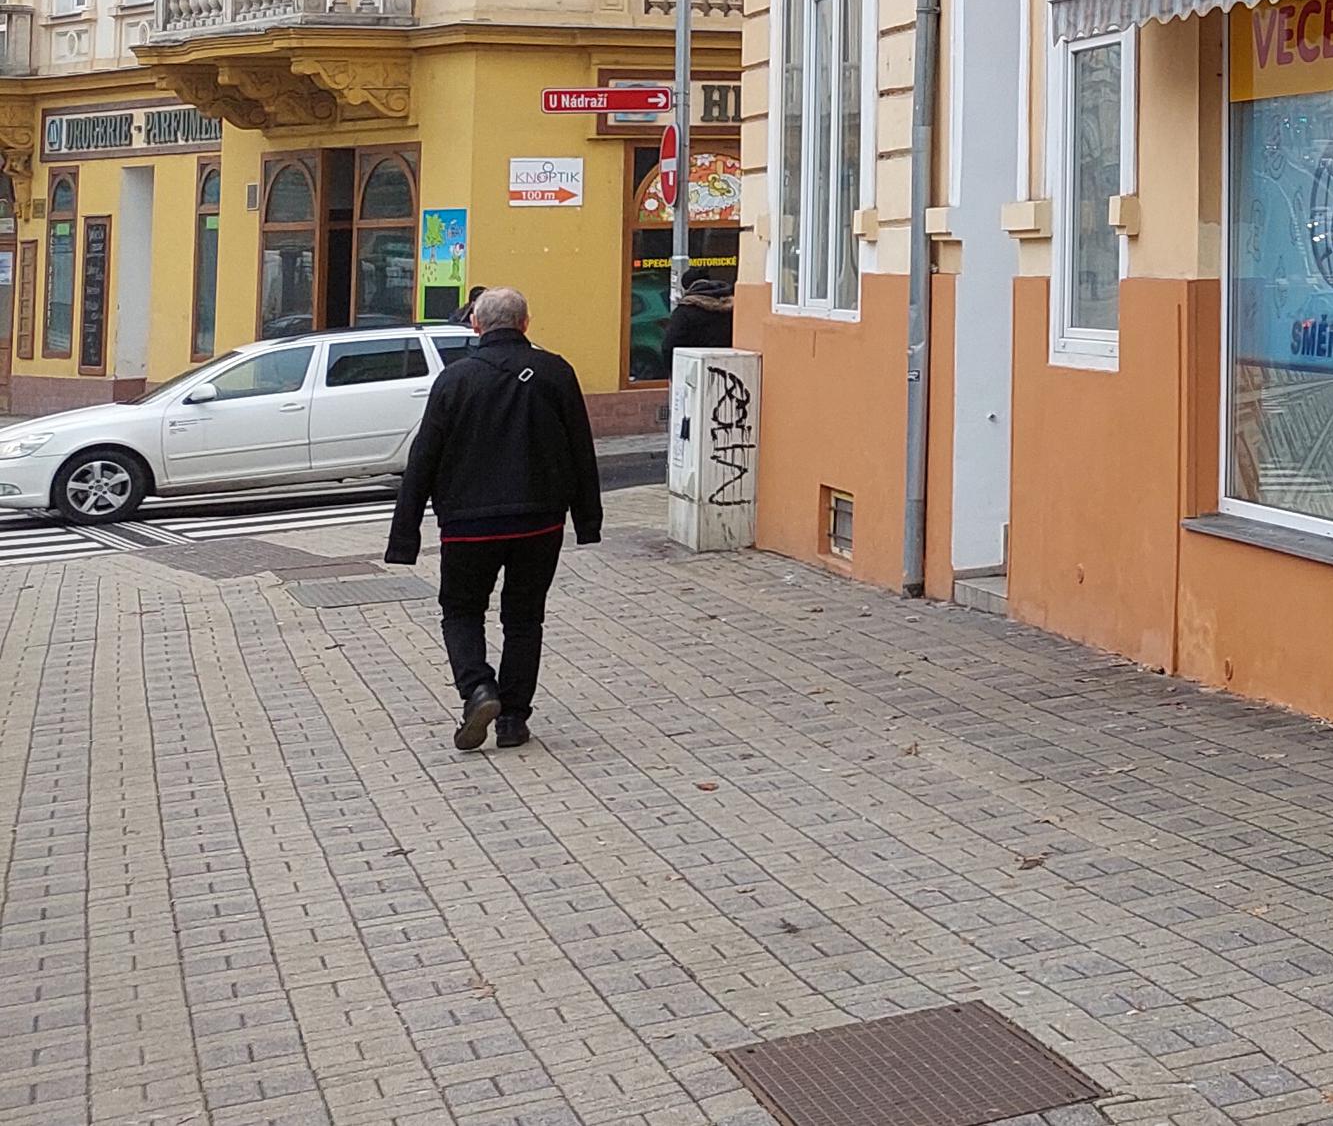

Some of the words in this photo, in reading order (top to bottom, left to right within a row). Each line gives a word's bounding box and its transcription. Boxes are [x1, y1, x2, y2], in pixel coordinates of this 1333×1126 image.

[549, 94, 558, 108] U
[561, 93, 608, 109] Nádraží
[64, 113, 134, 150] DROGERIE
[515, 170, 580, 184] KNOPTIK
[522, 191, 541, 201] 100
[544, 192, 556, 201] m
